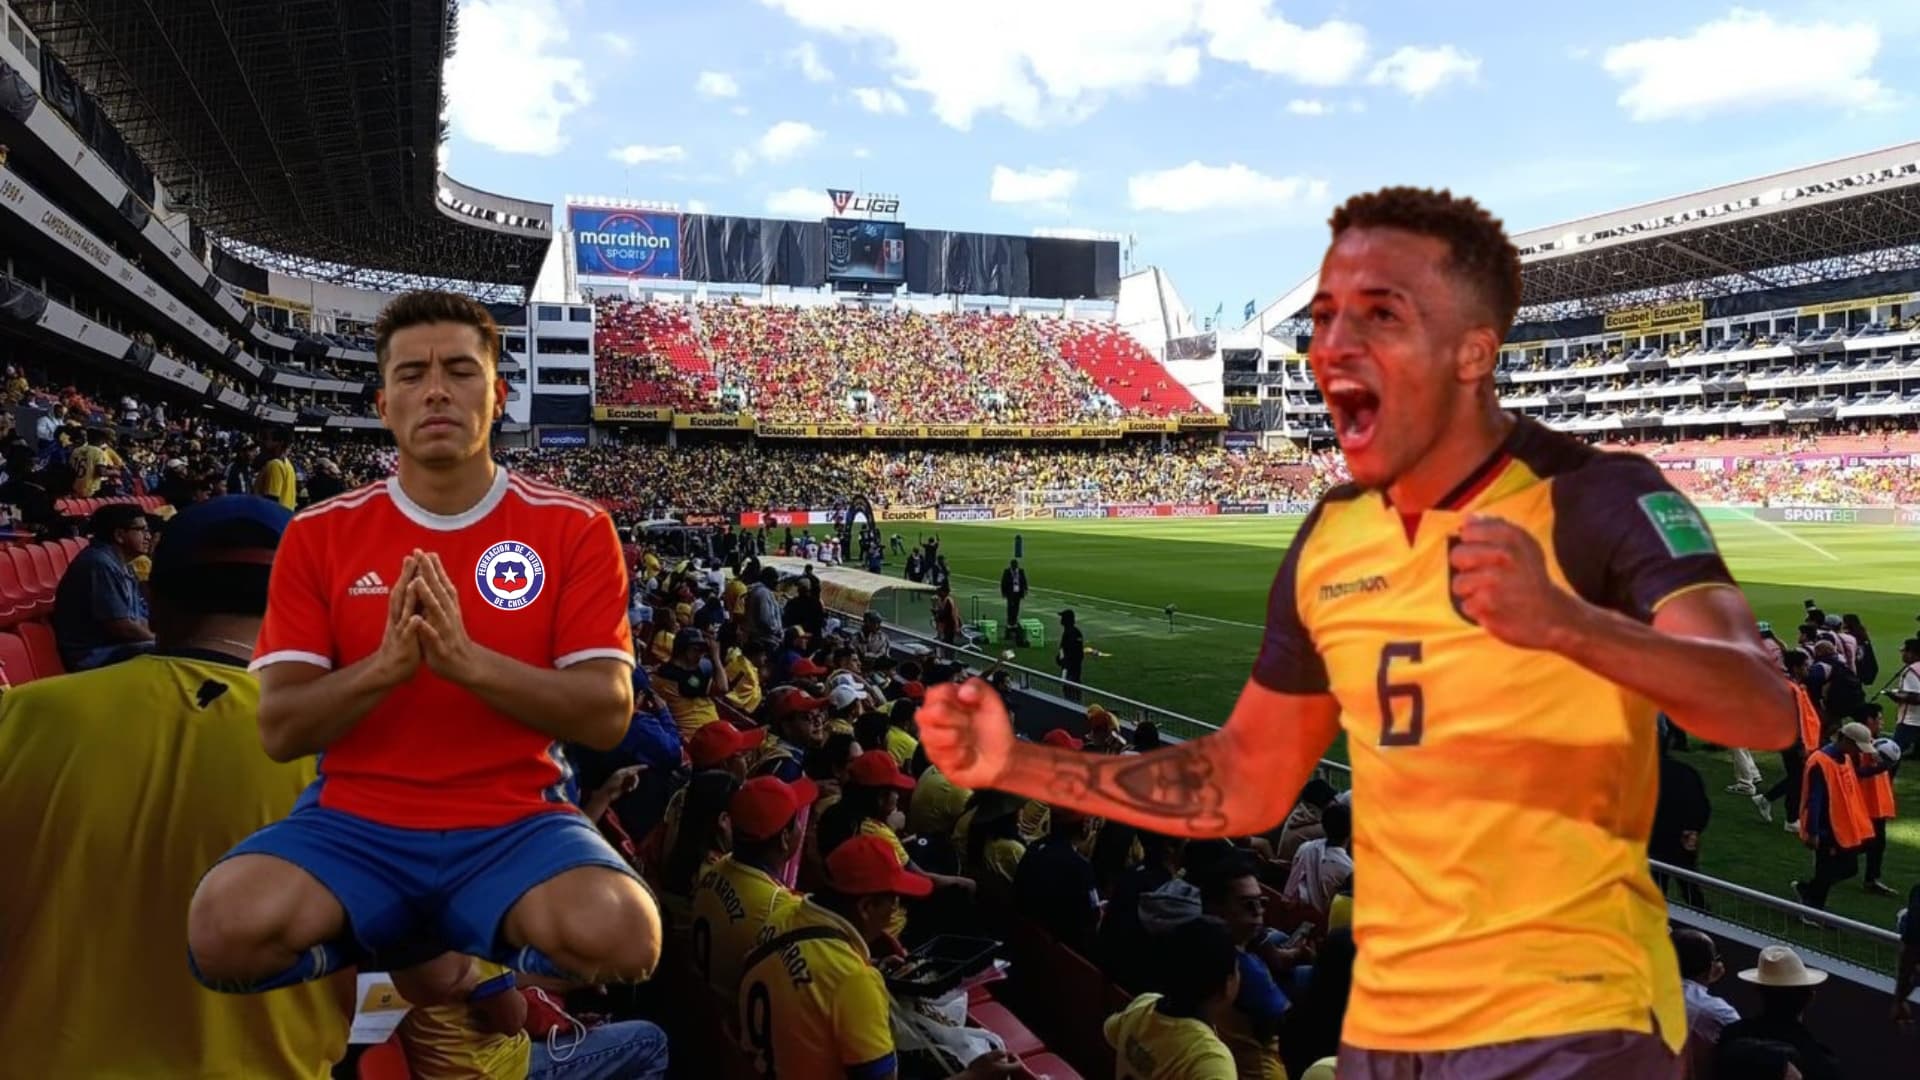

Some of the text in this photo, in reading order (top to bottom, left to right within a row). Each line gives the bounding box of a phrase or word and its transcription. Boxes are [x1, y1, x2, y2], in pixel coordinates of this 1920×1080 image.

[580, 231, 670, 249] marathon
[607, 249, 646, 259] SPORTS
[1654, 302, 1701, 319] Ecuabet
[1606, 311, 1650, 326] Ecuabet
[607, 408, 658, 420] Ecuabet
[1181, 415, 1218, 425] Ecuabet
[690, 416, 739, 427] Ecuabet
[1129, 421, 1167, 431] Ecuabet
[759, 424, 807, 435] Ecuabet
[816, 426, 863, 436] Ecuabet
[875, 427, 920, 436] Ecuabet
[927, 427, 970, 437] Ecuabet
[981, 427, 1023, 437] Ecuabet
[1030, 428, 1071, 437] Ecuabet
[882, 510, 928, 520] Ecuabet
[939, 509, 993, 520] marathon
[1784, 509, 1857, 521] SPORTBET
[478, 543, 542, 577] FEDERACION DE FUTBOL
[493, 596, 528, 608] DE CHILE
[1377, 642, 1424, 746] 6
